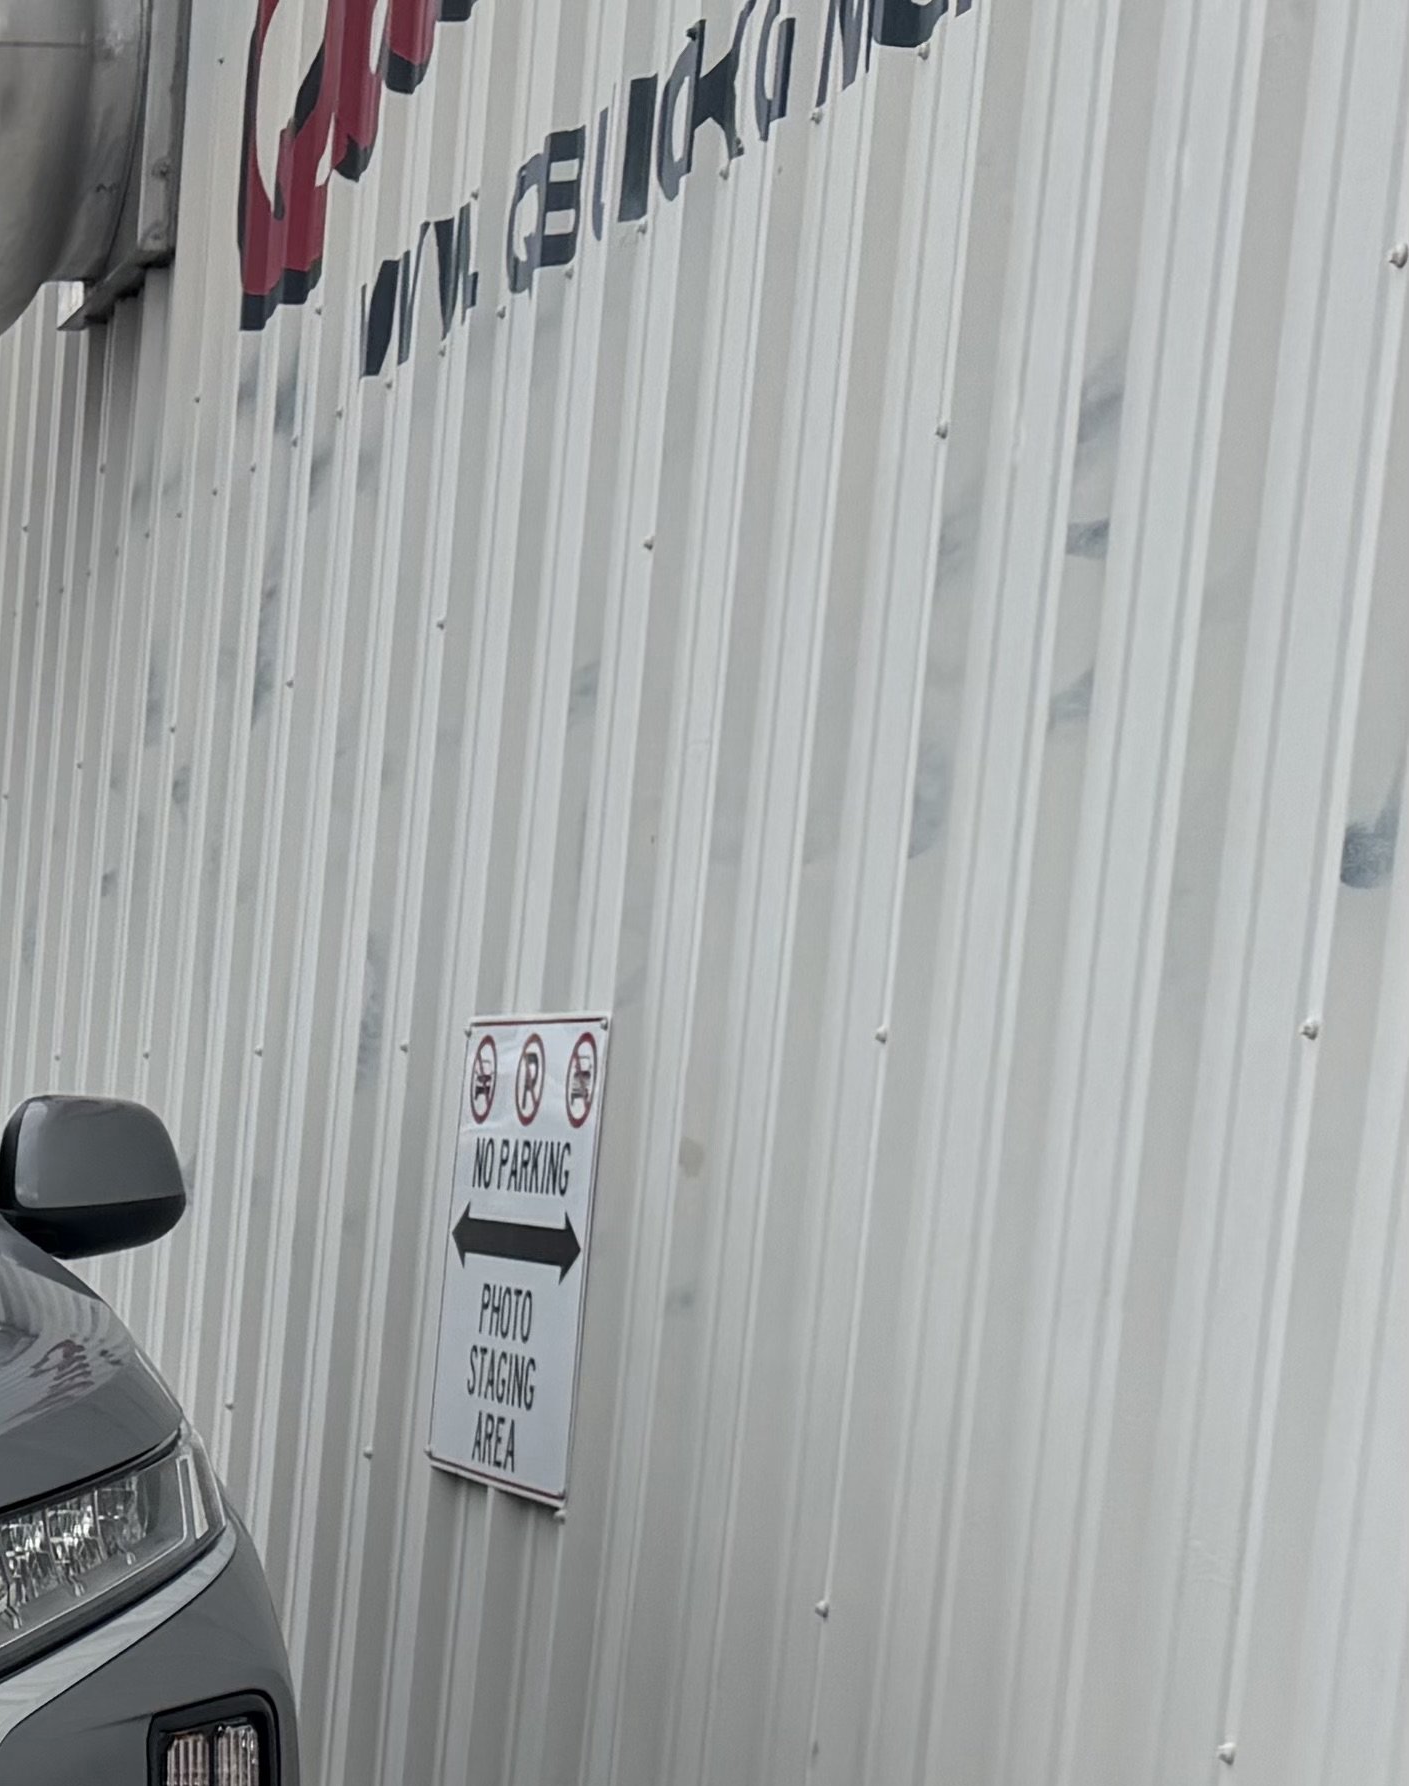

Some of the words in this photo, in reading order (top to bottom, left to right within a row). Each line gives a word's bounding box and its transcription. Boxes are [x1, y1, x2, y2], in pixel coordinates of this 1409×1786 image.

[472, 1137, 495, 1188] NO
[498, 1139, 572, 1197] PARKING
[479, 1283, 533, 1343] PHOTO
[466, 1344, 537, 1411] STAGING
[471, 1412, 516, 1473] AREA
